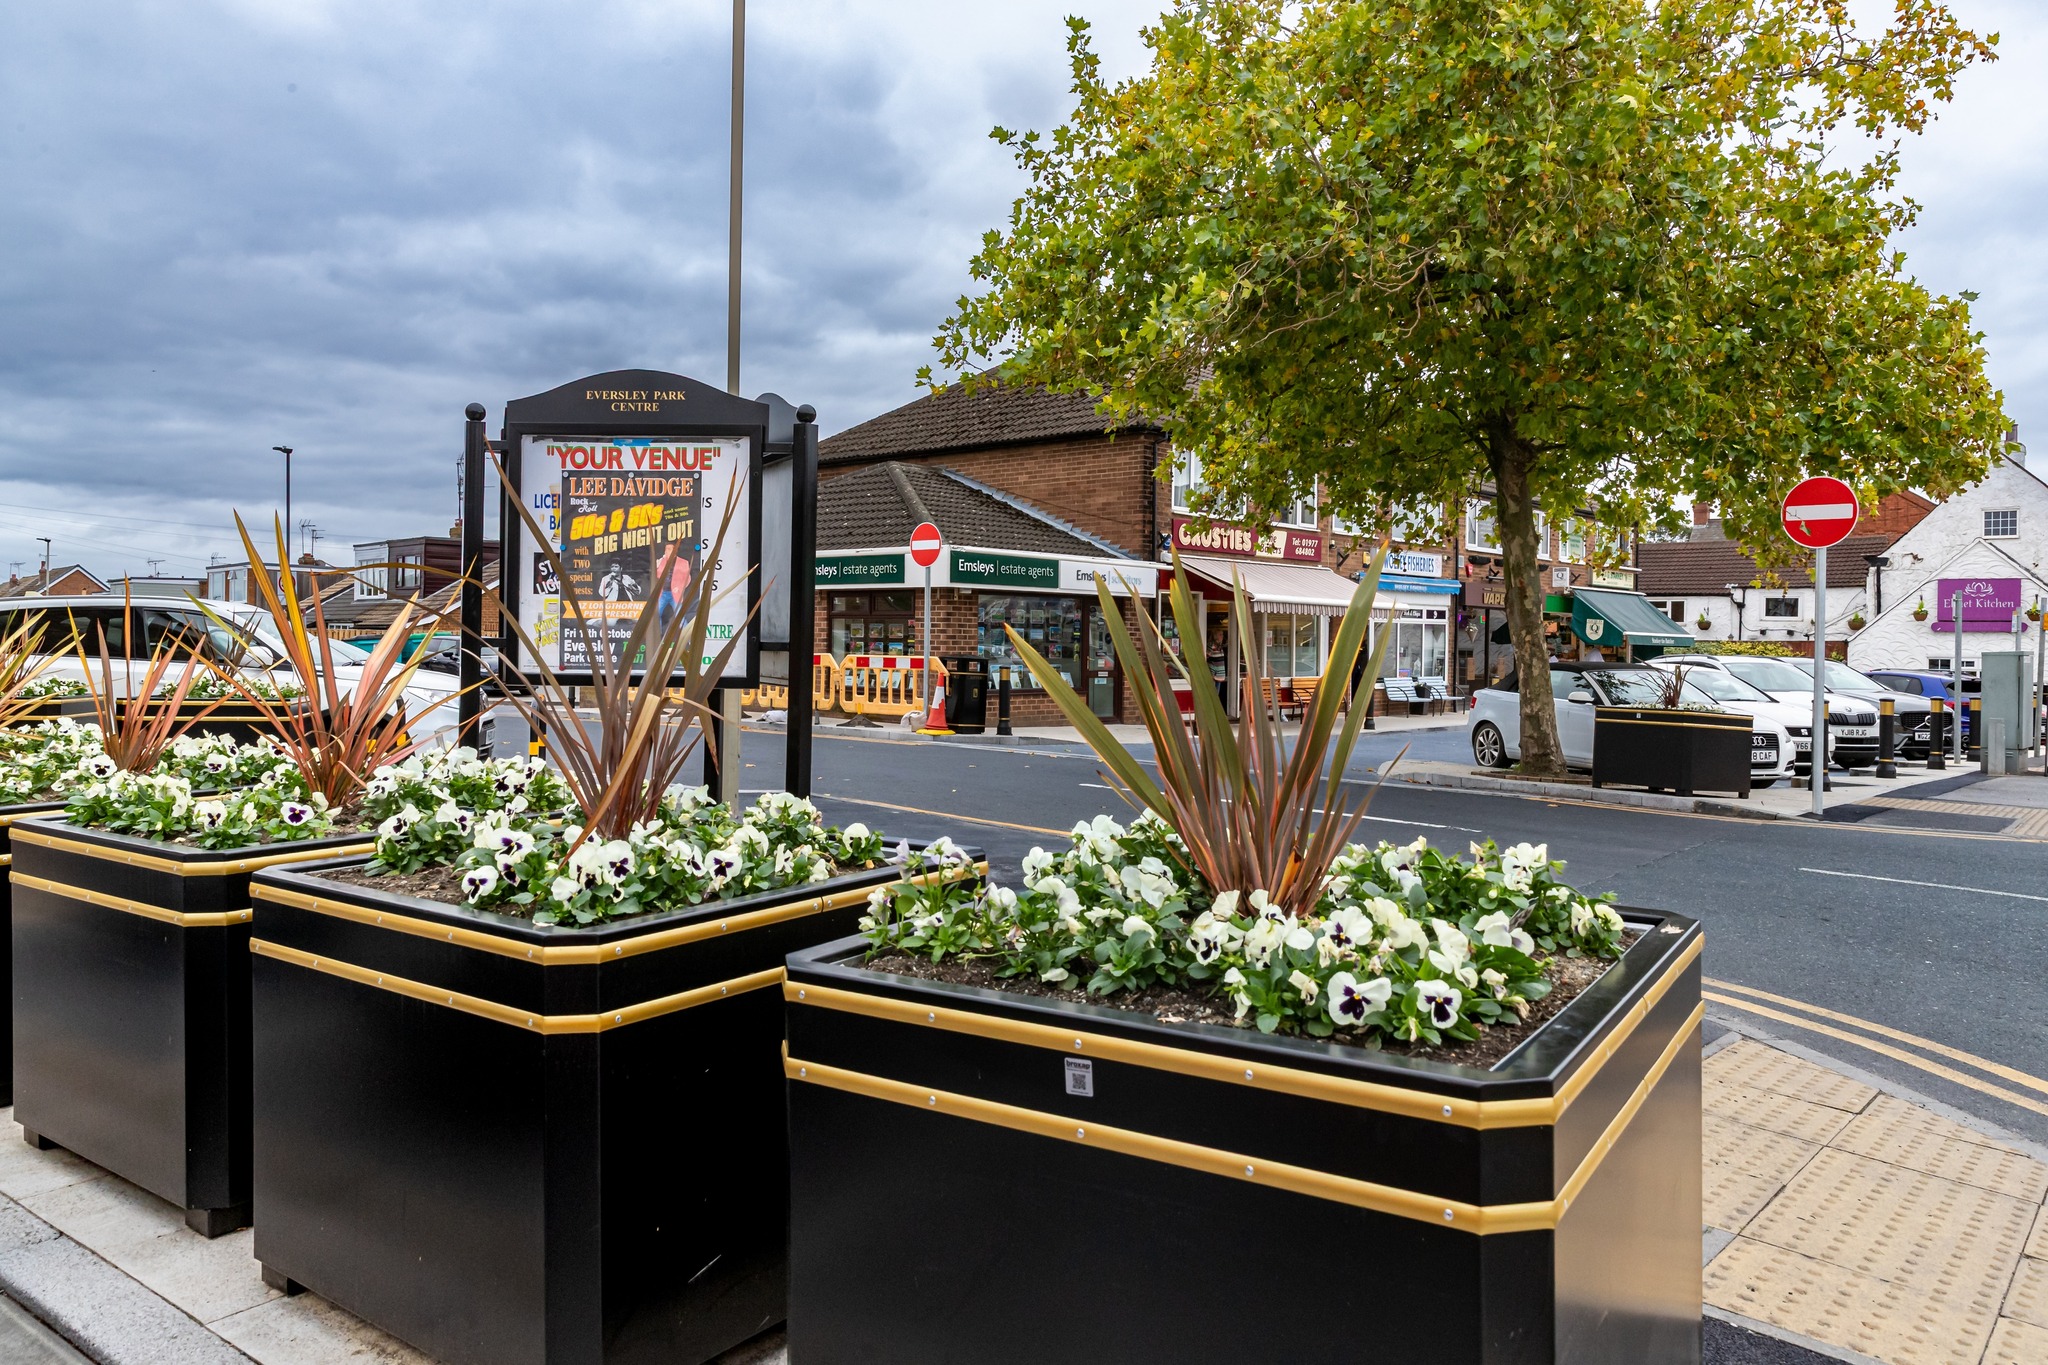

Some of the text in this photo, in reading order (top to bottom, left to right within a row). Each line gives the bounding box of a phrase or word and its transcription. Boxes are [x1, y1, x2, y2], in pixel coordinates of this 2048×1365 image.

[586, 390, 686, 400] EVERSLEY PARK
[611, 402, 660, 412] CENTRE
[546, 445, 721, 471] "YOUR VENUE"
[569, 477, 694, 497] LEE DAVIDGE
[534, 493, 560, 509] LICE
[570, 497, 589, 505] Rock
[578, 505, 598, 513] Roll
[569, 502, 665, 541] 50s & 60s
[594, 534, 618, 555] BIG
[667, 519, 694, 541] OUT
[1292, 537, 1318, 548] Tel: 01977
[574, 546, 590, 556] with
[1295, 547, 1315, 556] 684802
[573, 559, 591, 569] TWO
[958, 559, 1054, 579] Emsleys estate agents
[1407, 555, 1435, 573] FISHERIES
[842, 564, 868, 575] estate
[869, 563, 898, 577] agents
[569, 572, 593, 582] special
[1076, 569, 1142, 585] Emsls solitors
[574, 587, 593, 595] uests:
[588, 602, 644, 610] LONGTHORNE
[1944, 598, 2014, 608] Elet Kitchen
[1433, 610, 1438, 619] 9
[564, 628, 633, 638] Fri 1th ctobe
[564, 640, 616, 655] Evesly
[564, 652, 585, 662] Park
[1759, 752, 1772, 760] CAF
